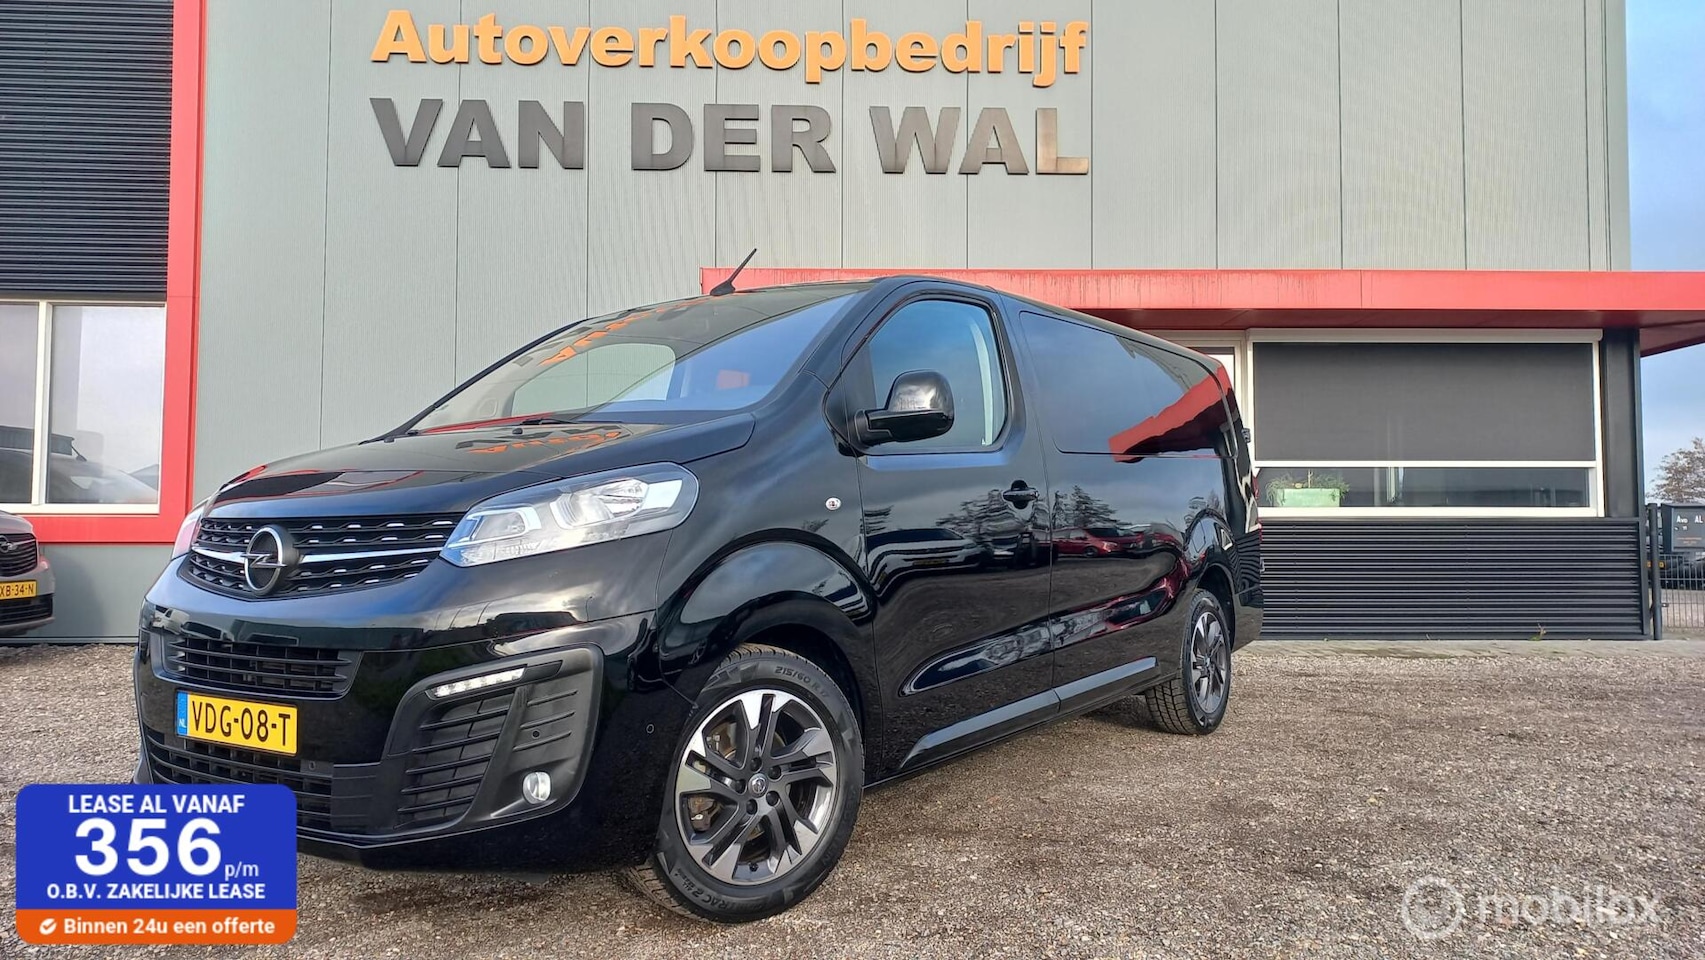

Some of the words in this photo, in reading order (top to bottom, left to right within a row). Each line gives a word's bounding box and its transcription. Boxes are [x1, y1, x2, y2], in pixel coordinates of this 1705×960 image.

[371, 9, 1089, 87] Autoverkoopbedrijf
[370, 97, 585, 171] VAN
[631, 102, 836, 174] DER
[870, 106, 1089, 175] WAL
[775, 665, 811, 683] 215/60
[191, 700, 291, 746] VDG-08-T
